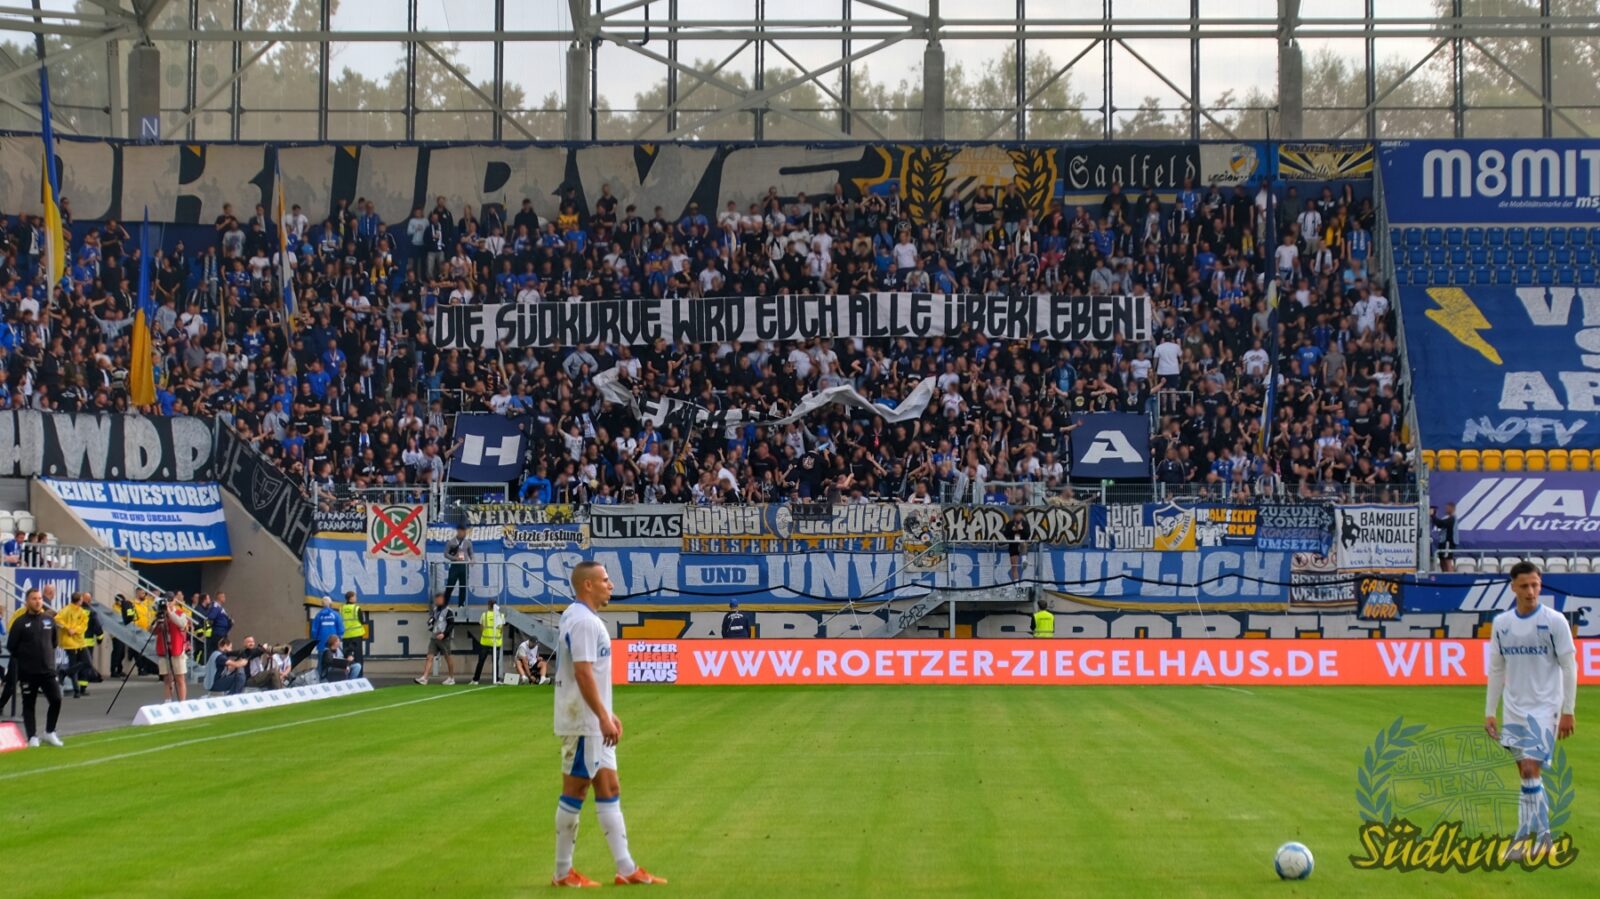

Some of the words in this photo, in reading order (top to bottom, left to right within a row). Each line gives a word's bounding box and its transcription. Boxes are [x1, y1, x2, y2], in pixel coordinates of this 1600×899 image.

[141, 117, 158, 136] N
[1069, 154, 1195, 188] Saalfeld
[436, 303, 484, 346] DIE
[496, 301, 661, 346] SÜDKURVE
[672, 299, 745, 342] WIRD
[756, 295, 838, 340] EUCH
[851, 293, 933, 337] ALLE
[944, 295, 1146, 340] ÜBERLEBEN!
[460, 433, 520, 466] H
[1080, 430, 1143, 463] A
[108, 483, 221, 506] INVESTOREN
[466, 510, 549, 524] WEIMAR
[592, 515, 682, 537] ULTRAS
[1361, 512, 1416, 527] BAMBULE
[118, 528, 216, 553] FUSSBALL
[1361, 528, 1416, 544] RANDALE
[701, 567, 747, 583] UND
[1292, 586, 1355, 601] WELCOME
[628, 641, 677, 652] RÖTZER
[628, 661, 677, 670] ELEMENT
[694, 650, 1338, 677] WWW.ROETZER-ZIEGELHAUS.DE
[1377, 642, 1467, 676] WIR
[628, 669, 677, 682] HAUS
